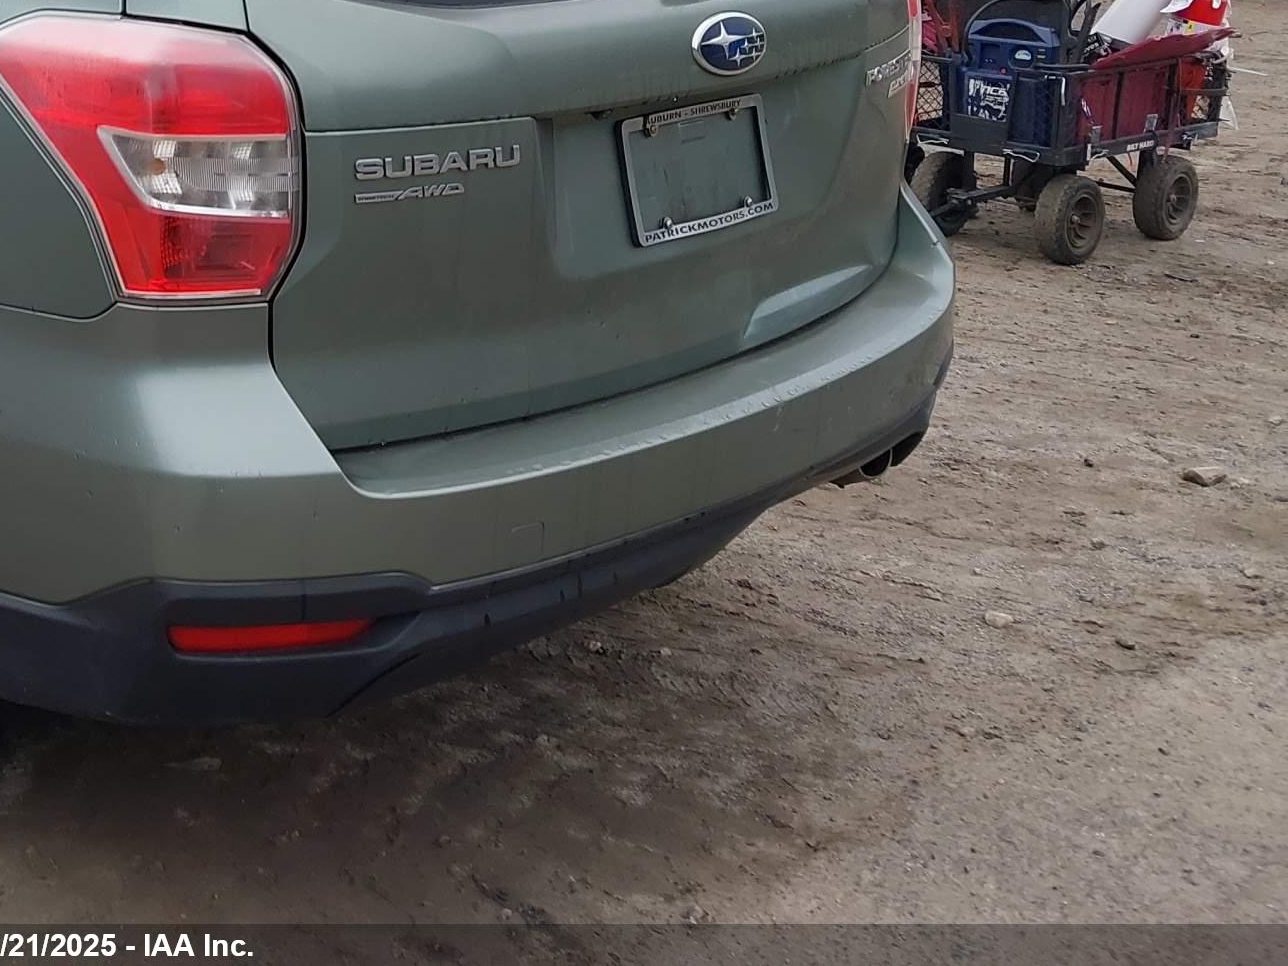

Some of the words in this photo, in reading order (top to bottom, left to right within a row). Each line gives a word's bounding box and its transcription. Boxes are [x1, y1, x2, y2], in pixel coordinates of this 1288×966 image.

[690, 99, 741, 116] SHREWSBURY
[355, 144, 521, 181] SUBARU
[397, 183, 464, 201] AWD
[645, 202, 774, 243] PATRICKMOTORS.COM
